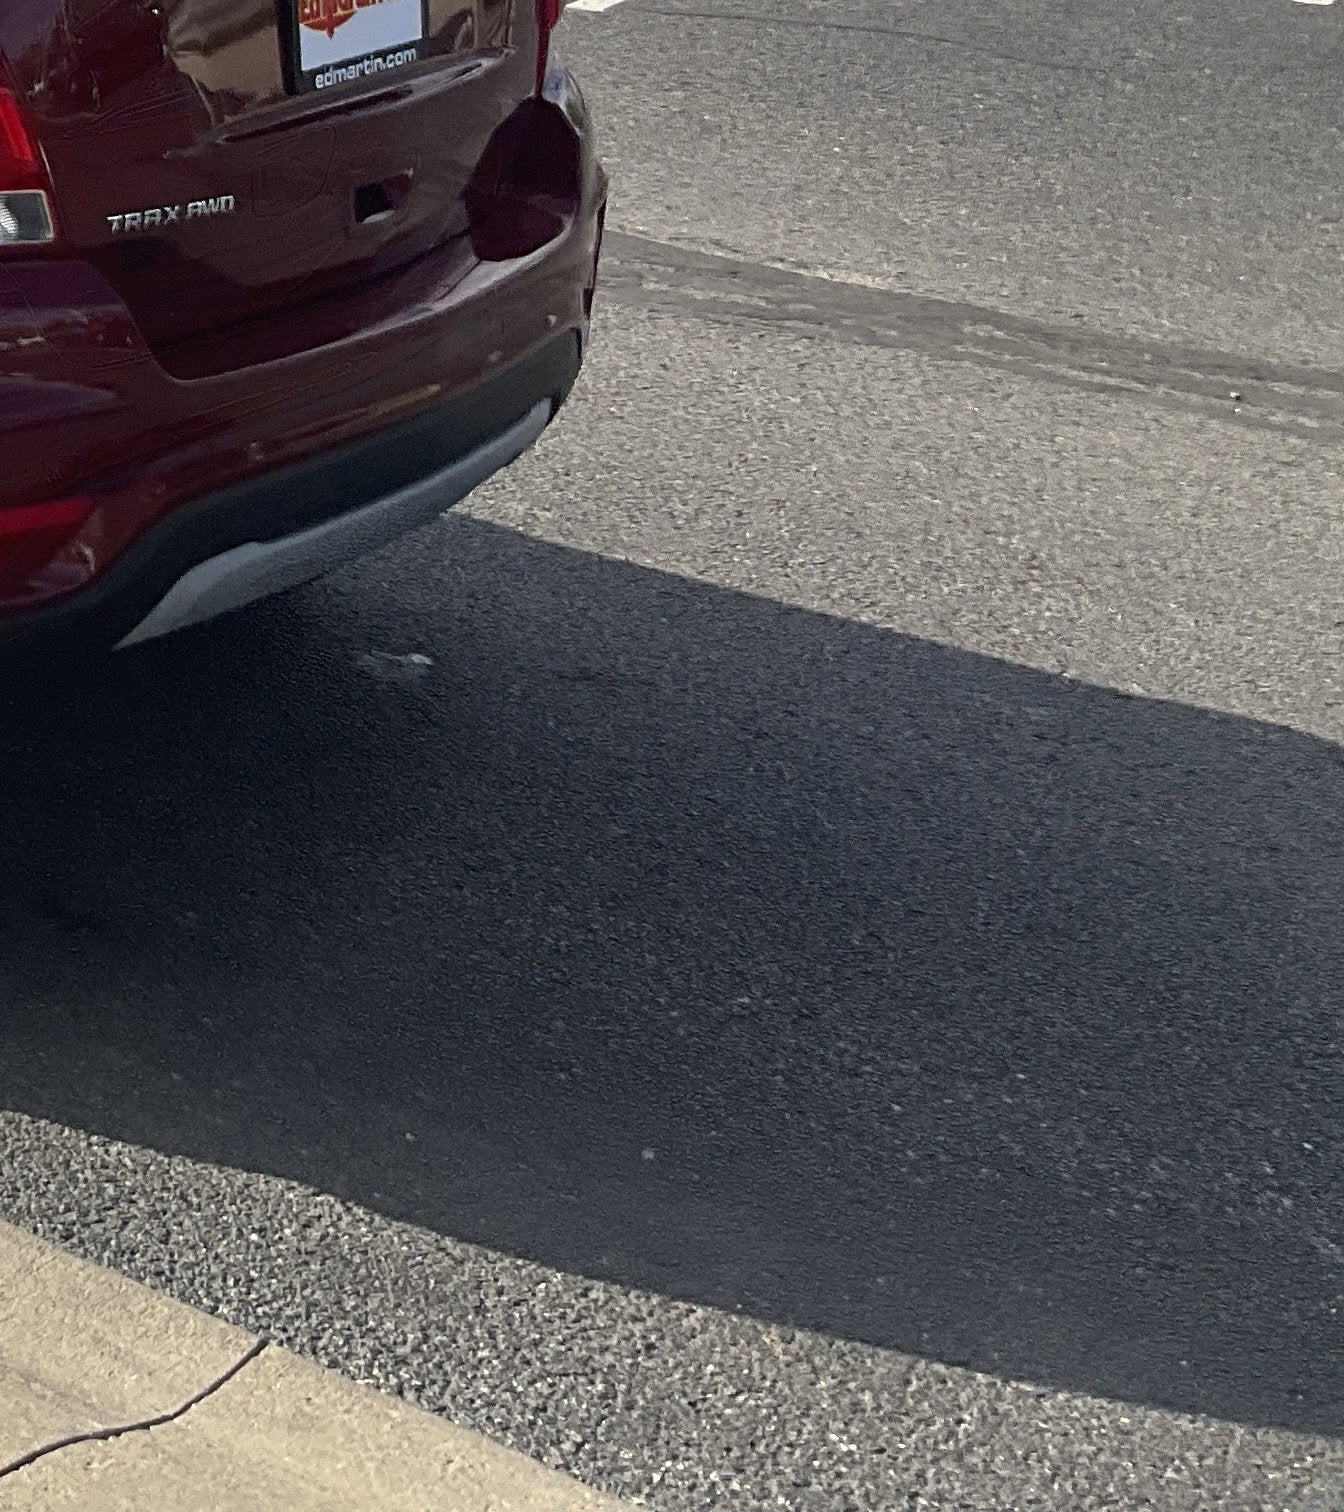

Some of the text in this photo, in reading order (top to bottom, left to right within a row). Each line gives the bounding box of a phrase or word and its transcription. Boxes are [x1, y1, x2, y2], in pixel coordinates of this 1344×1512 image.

[315, 47, 417, 89] edmartin.com
[107, 195, 236, 233] TRAX AWD
